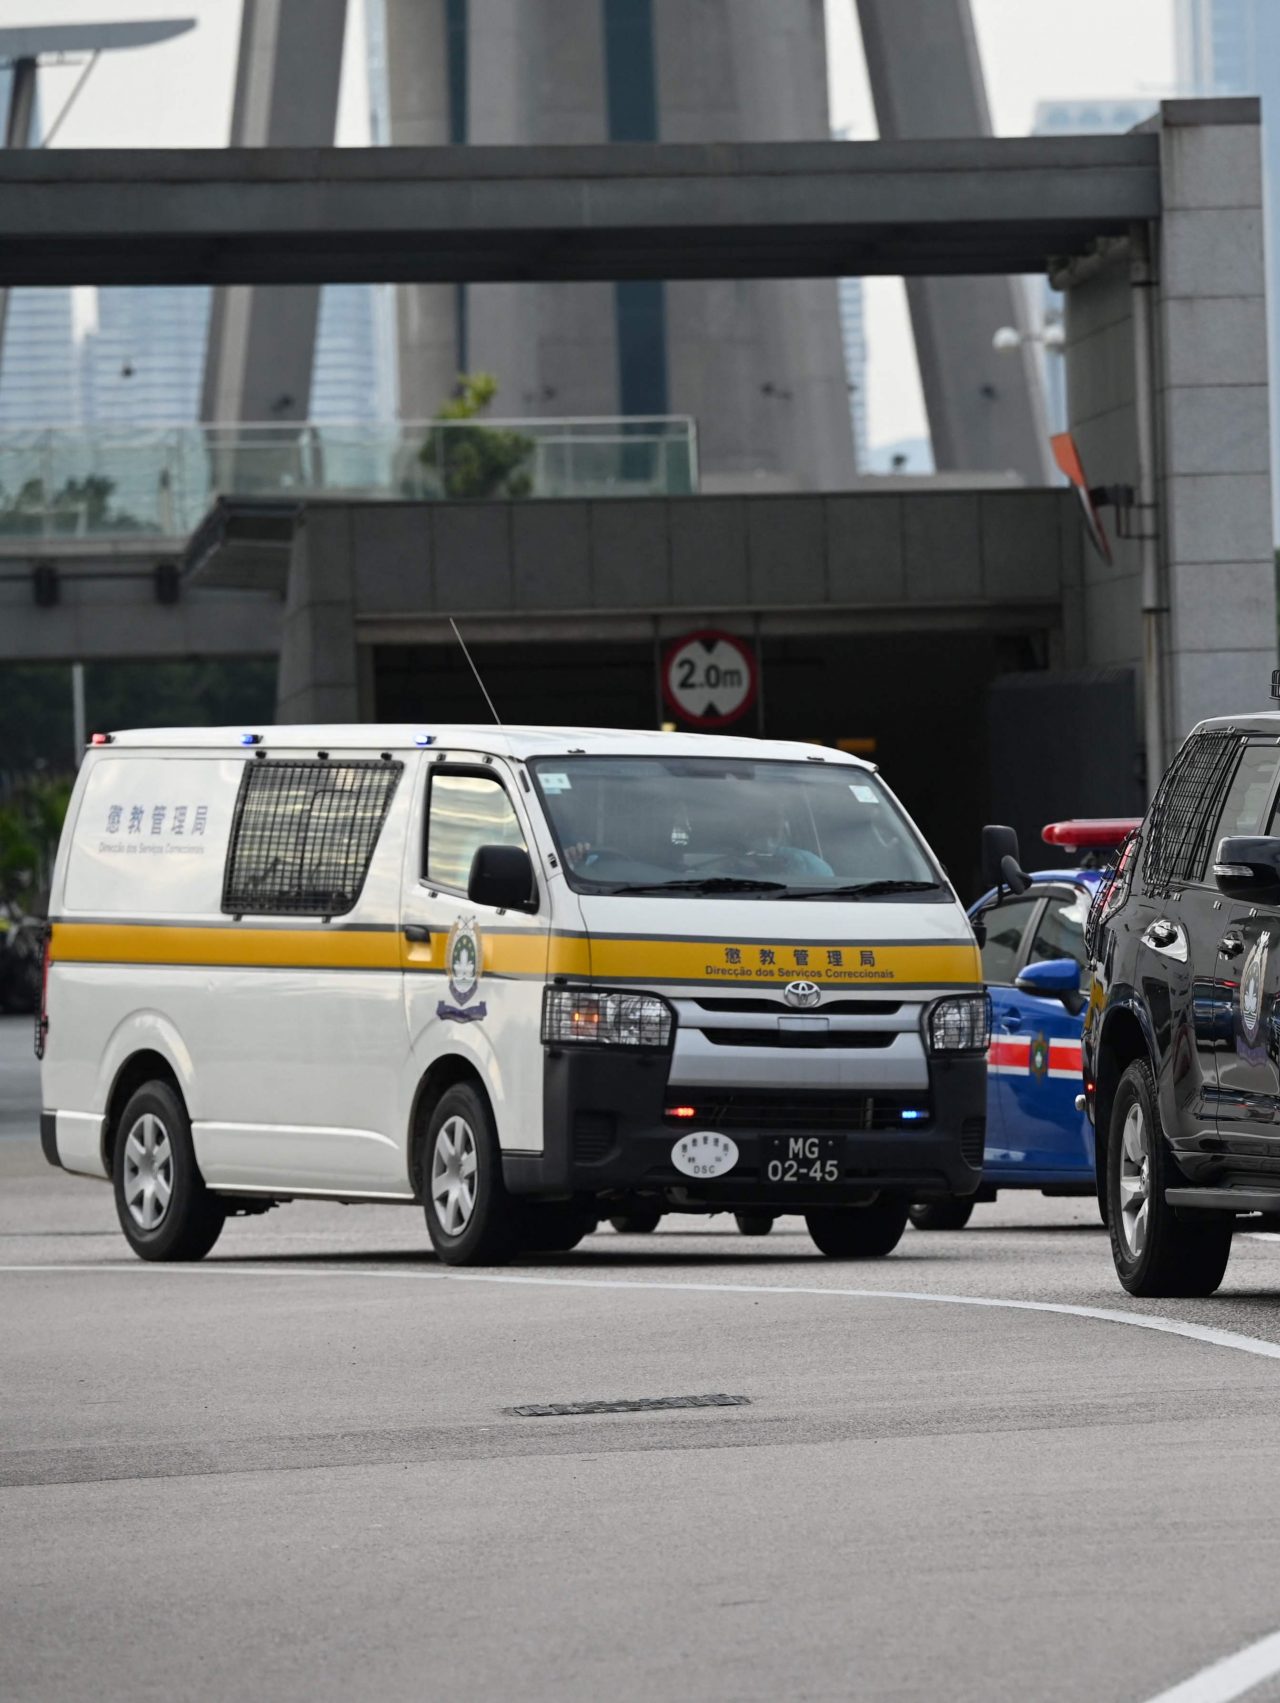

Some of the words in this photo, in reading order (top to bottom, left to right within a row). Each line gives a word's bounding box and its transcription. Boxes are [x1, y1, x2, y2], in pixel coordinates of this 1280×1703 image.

[678, 658, 743, 689] 2.0m
[725, 947, 876, 967] 懲教管理局
[705, 965, 753, 978] Direcção
[755, 966, 775, 978] dos
[825, 968, 895, 980] Correccionais
[788, 1137, 819, 1159] MG
[693, 1164, 716, 1175] DSC
[768, 1160, 839, 1182] 02-45
